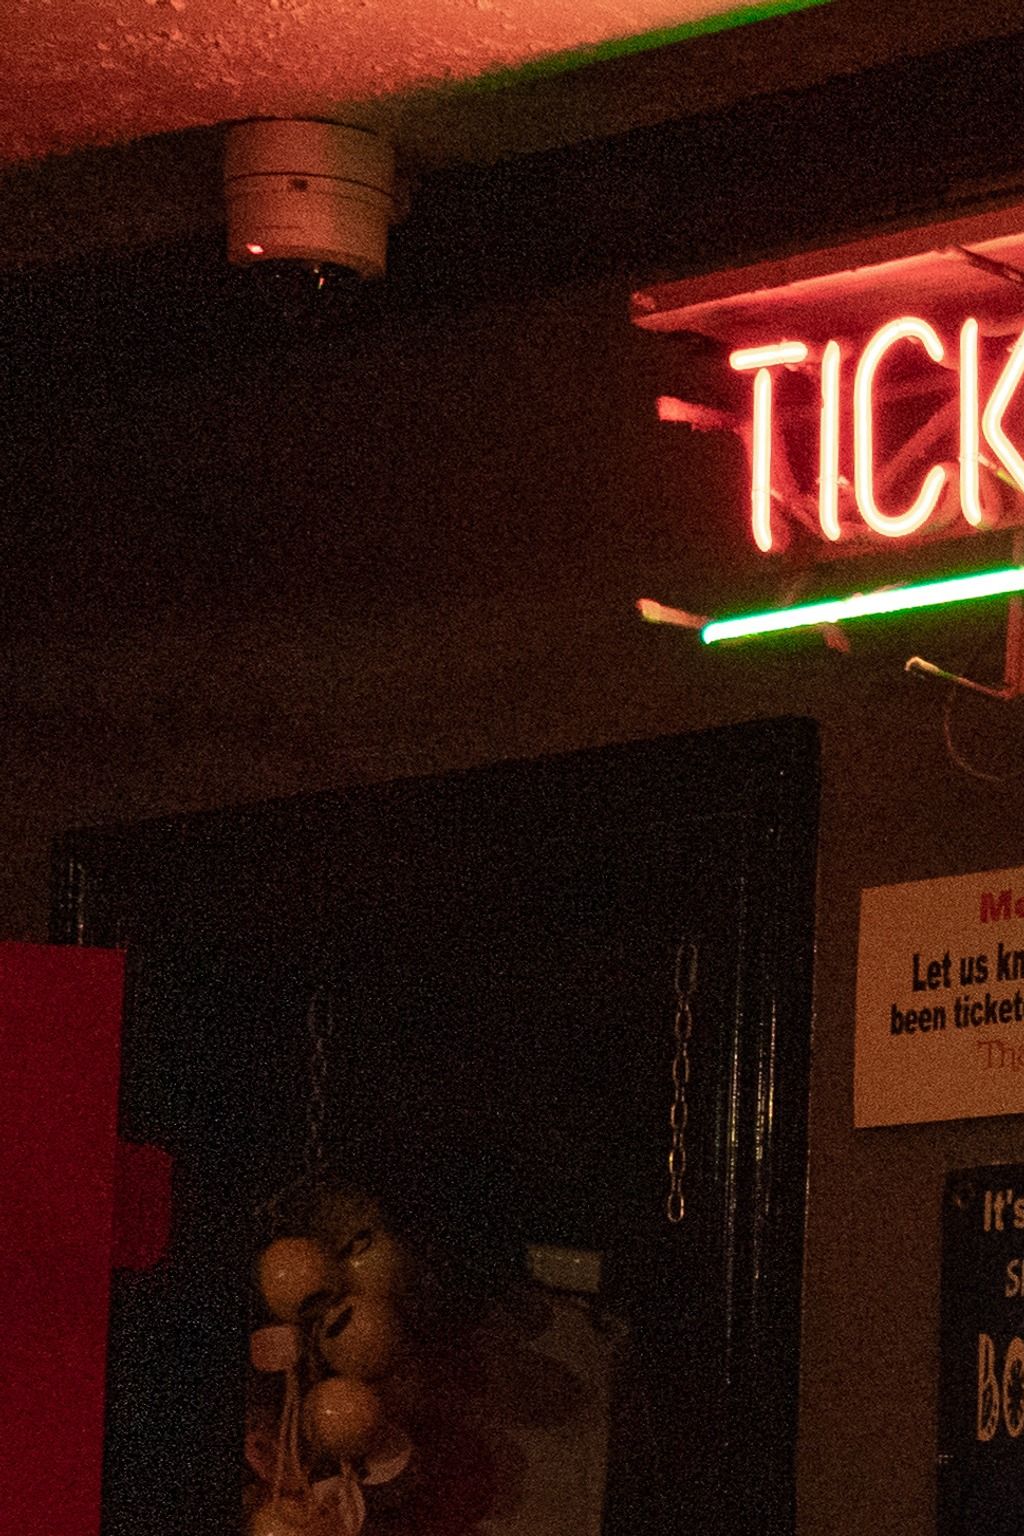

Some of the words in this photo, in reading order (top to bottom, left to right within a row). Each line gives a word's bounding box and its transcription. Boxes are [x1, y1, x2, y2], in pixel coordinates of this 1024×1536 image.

[912, 952, 952, 992] Let
[960, 953, 989, 986] us
[890, 1003, 946, 1035] been
